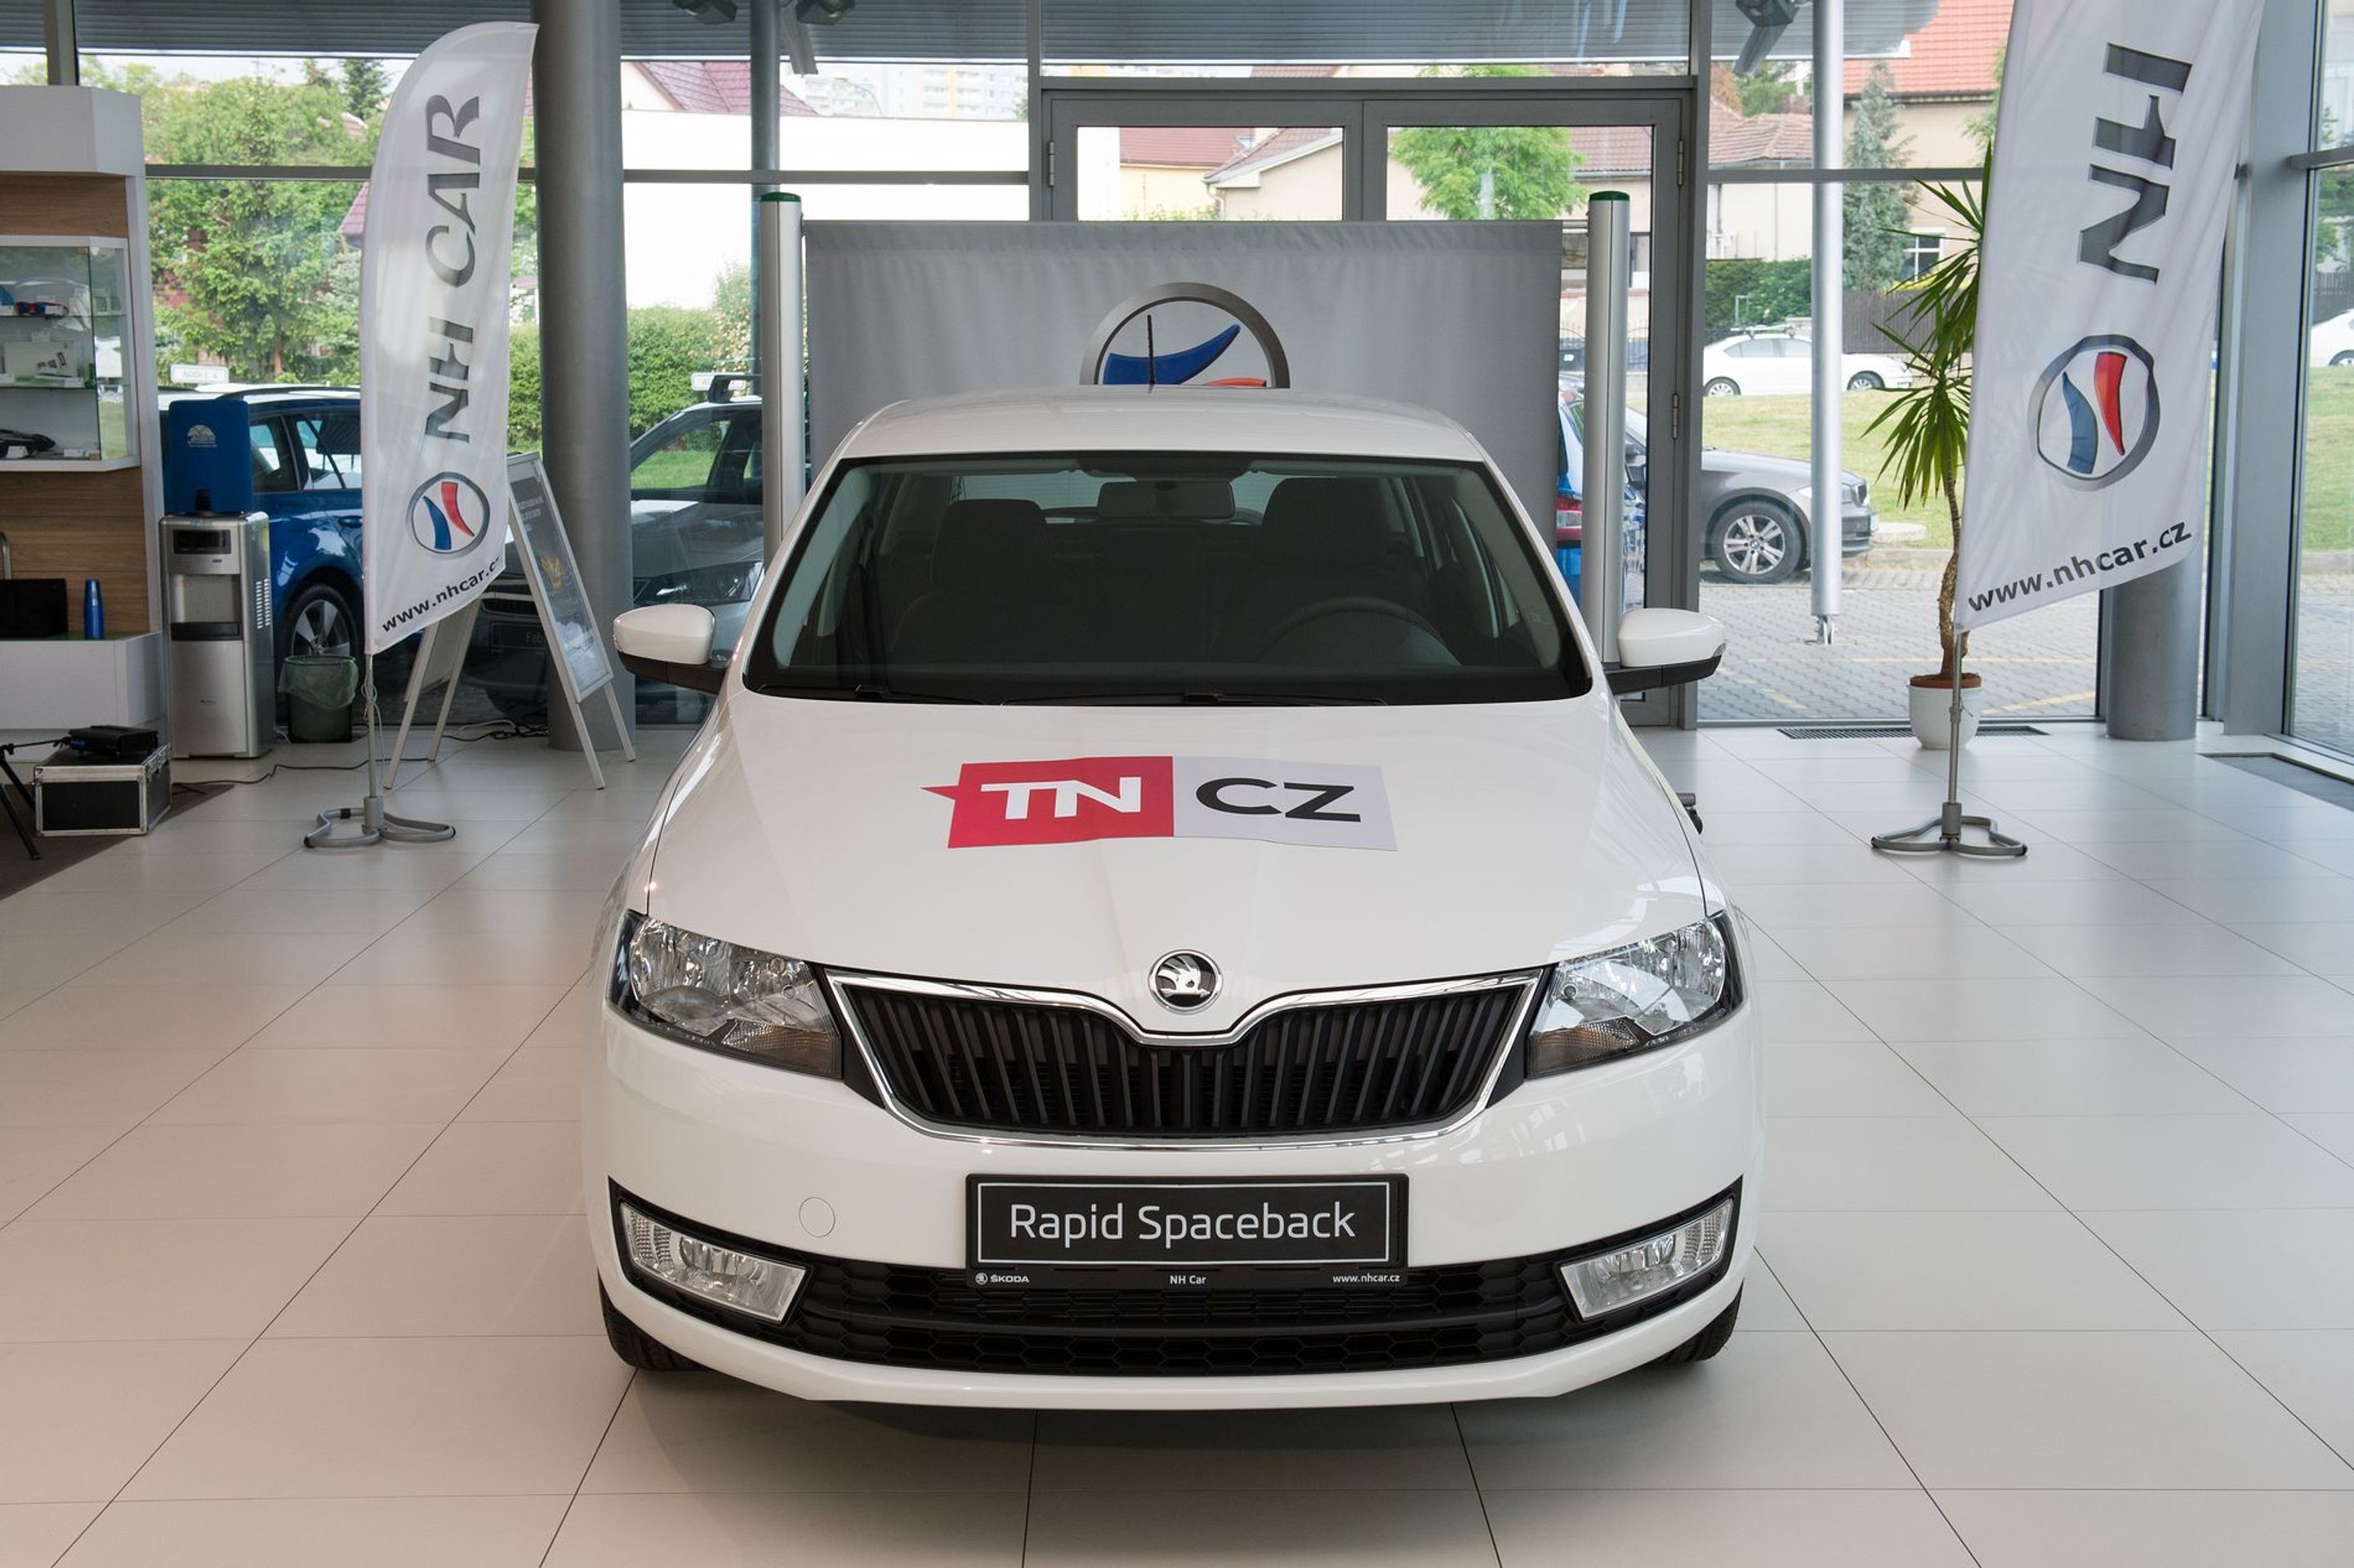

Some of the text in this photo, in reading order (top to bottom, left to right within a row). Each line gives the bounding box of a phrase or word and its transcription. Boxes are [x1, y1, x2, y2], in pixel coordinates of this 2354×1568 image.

[2077, 42, 2192, 286] NH
[426, 94, 481, 443] NH CAR
[1968, 521, 2192, 612] www.nhcar.cz
[382, 555, 501, 632] www.nhcar.c
[981, 777, 1362, 822] TN CZ
[1010, 1201, 1356, 1249] Rapid Spaceback
[990, 1273, 1030, 1284] ŠKODA
[1170, 1275, 1206, 1285] NH Car
[1332, 1273, 1400, 1283] www.nhcar.cz
